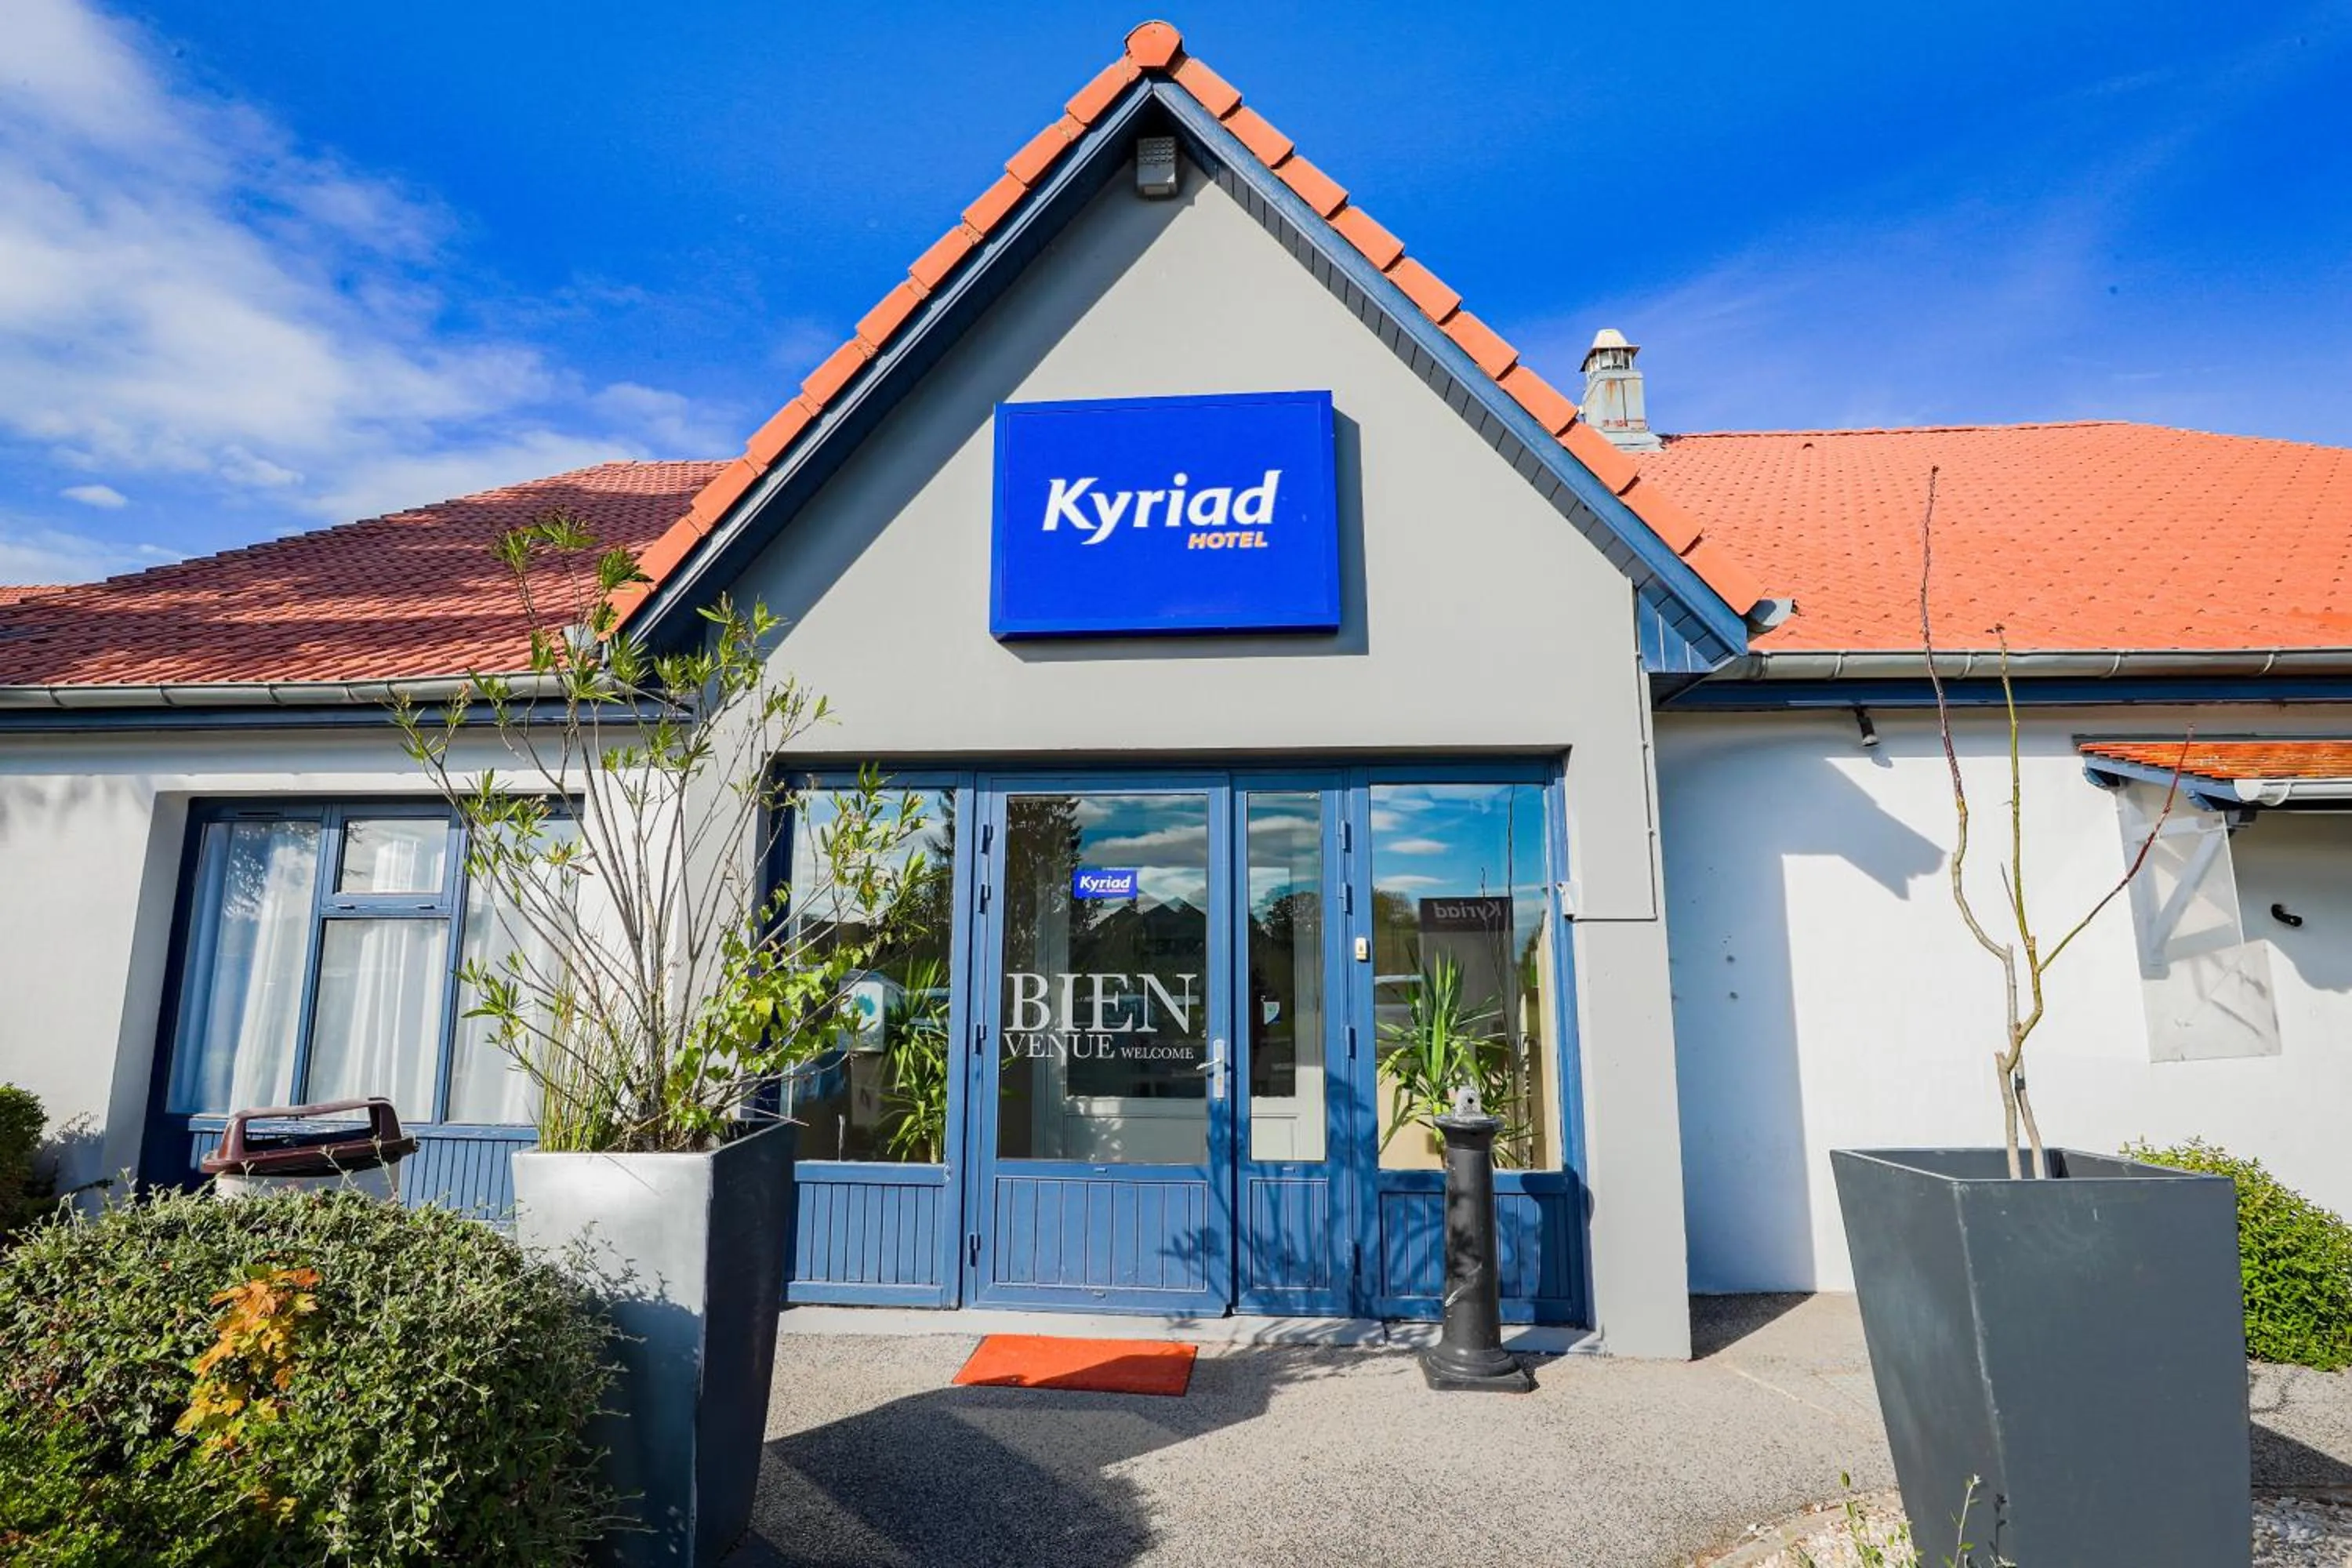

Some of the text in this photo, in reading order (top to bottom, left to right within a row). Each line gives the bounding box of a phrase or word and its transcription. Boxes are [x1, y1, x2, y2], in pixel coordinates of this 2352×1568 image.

[1042, 470, 1283, 545] Kyriad
[1187, 531, 1269, 550] HOTEL
[1080, 875, 1132, 892] Kyriad
[1004, 972, 1198, 1034] BIEN
[1003, 1033, 1194, 1059] VENUE WELCOME
